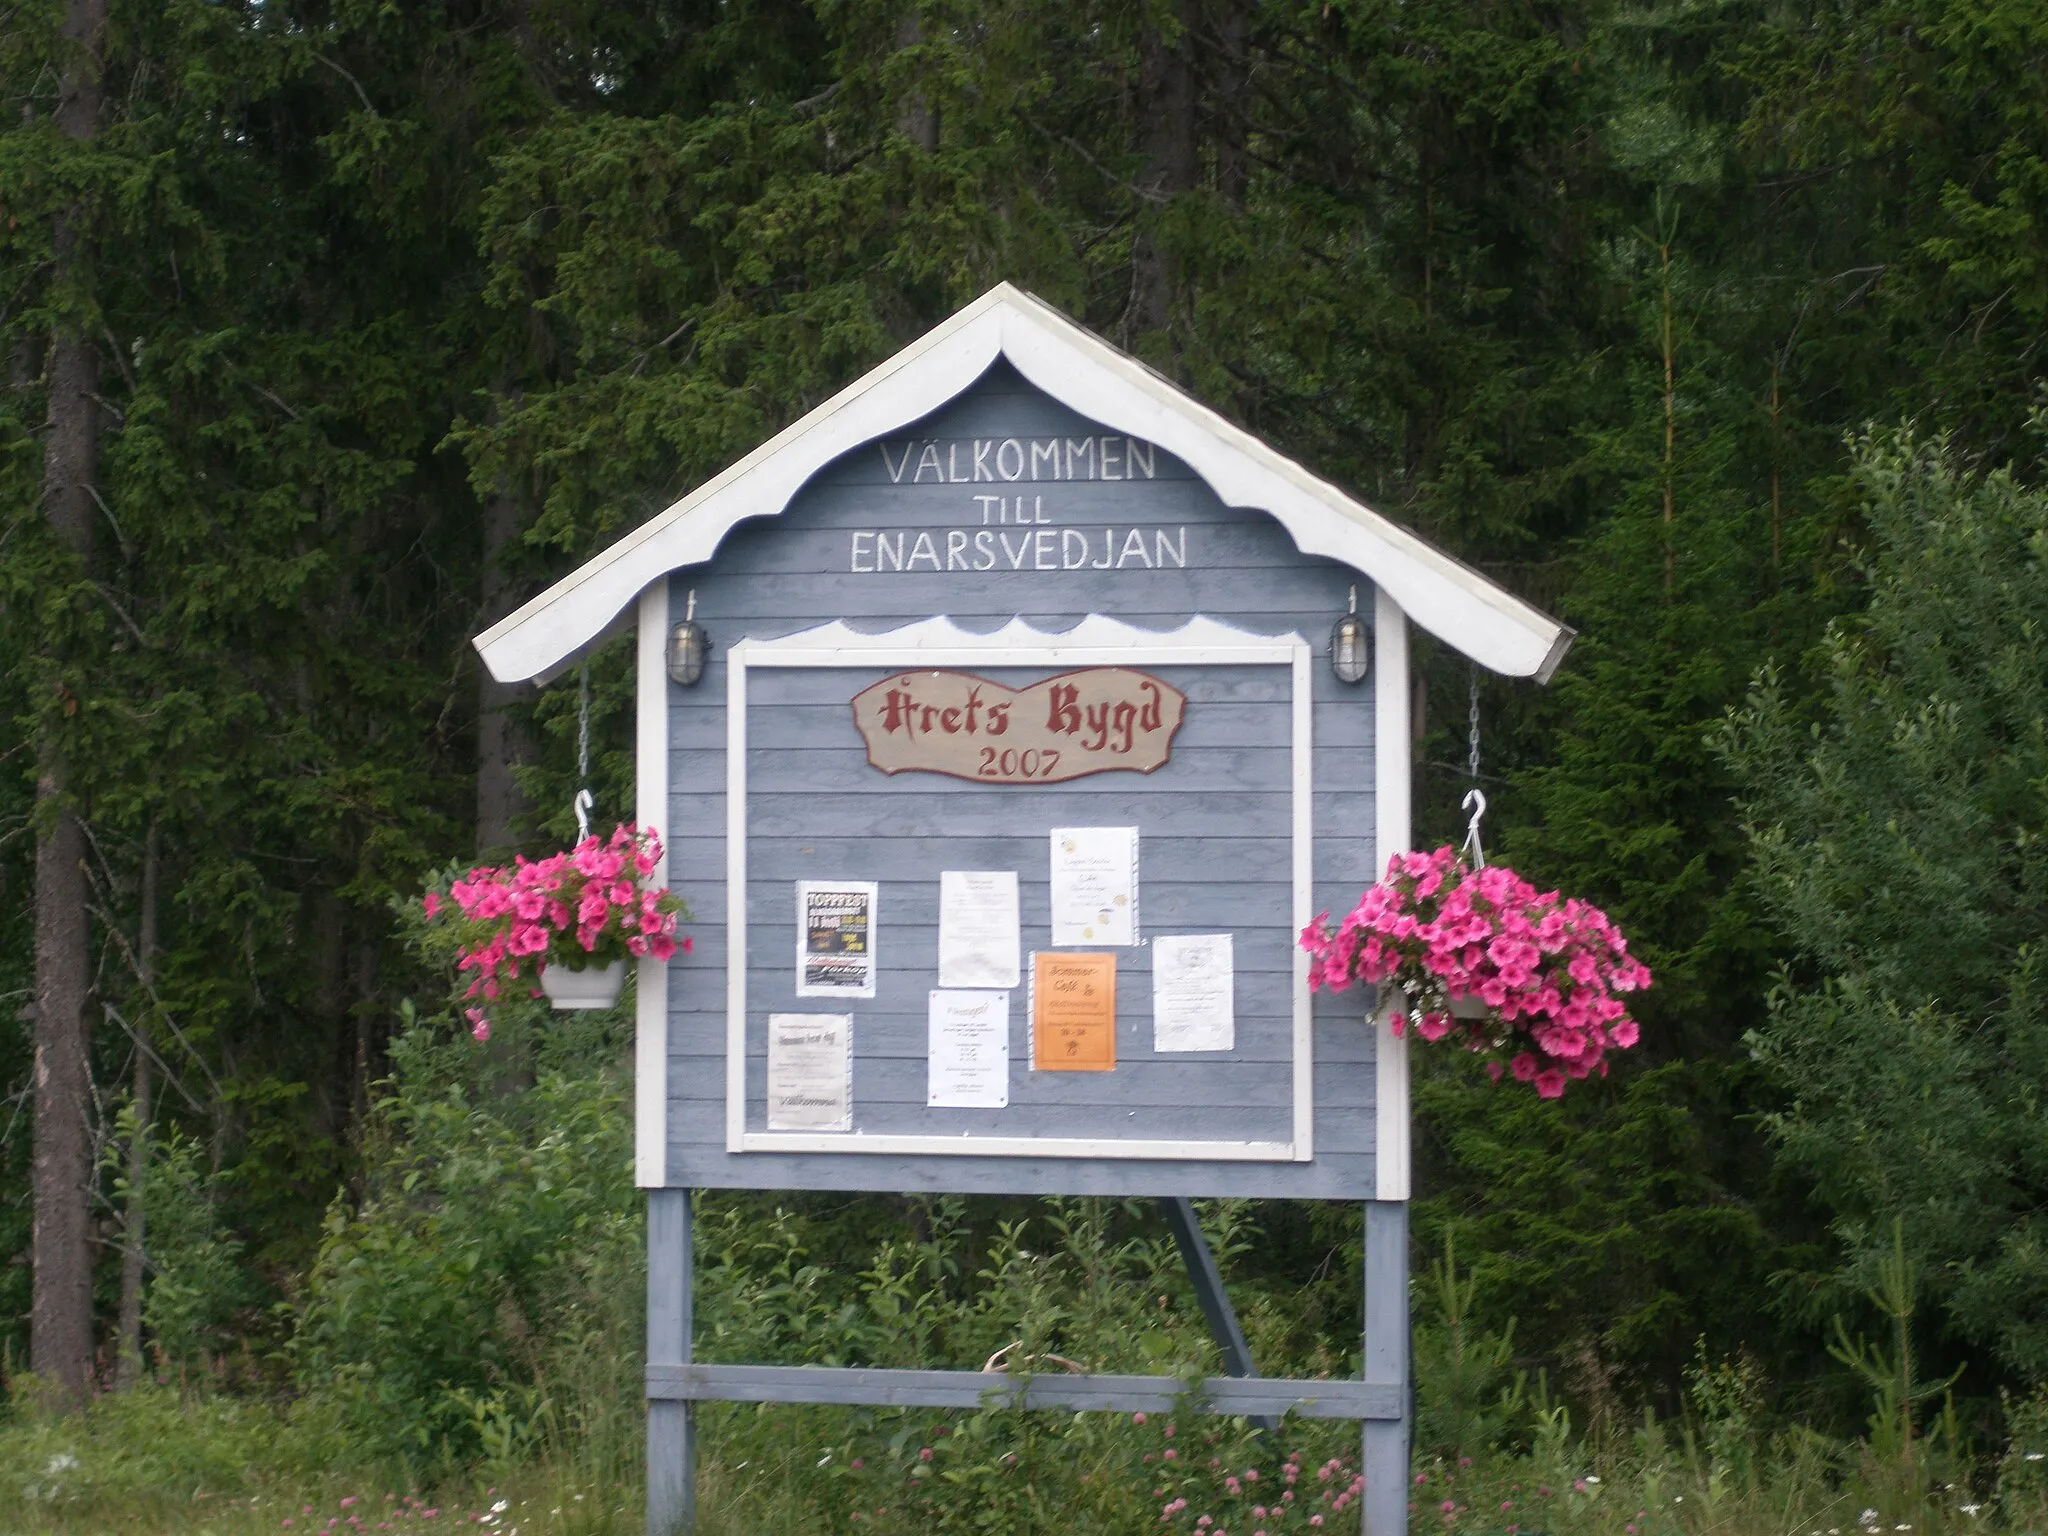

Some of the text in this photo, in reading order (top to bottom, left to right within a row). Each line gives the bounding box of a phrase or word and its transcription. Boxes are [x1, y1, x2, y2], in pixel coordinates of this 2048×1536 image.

[879, 436, 1156, 484] VÄLKOMMEN
[973, 495, 1052, 525] TILL
[851, 526, 1187, 573] ENARSVEDJAN
[877, 676, 1162, 754] Årets Bygd
[978, 747, 1061, 777] 2007
